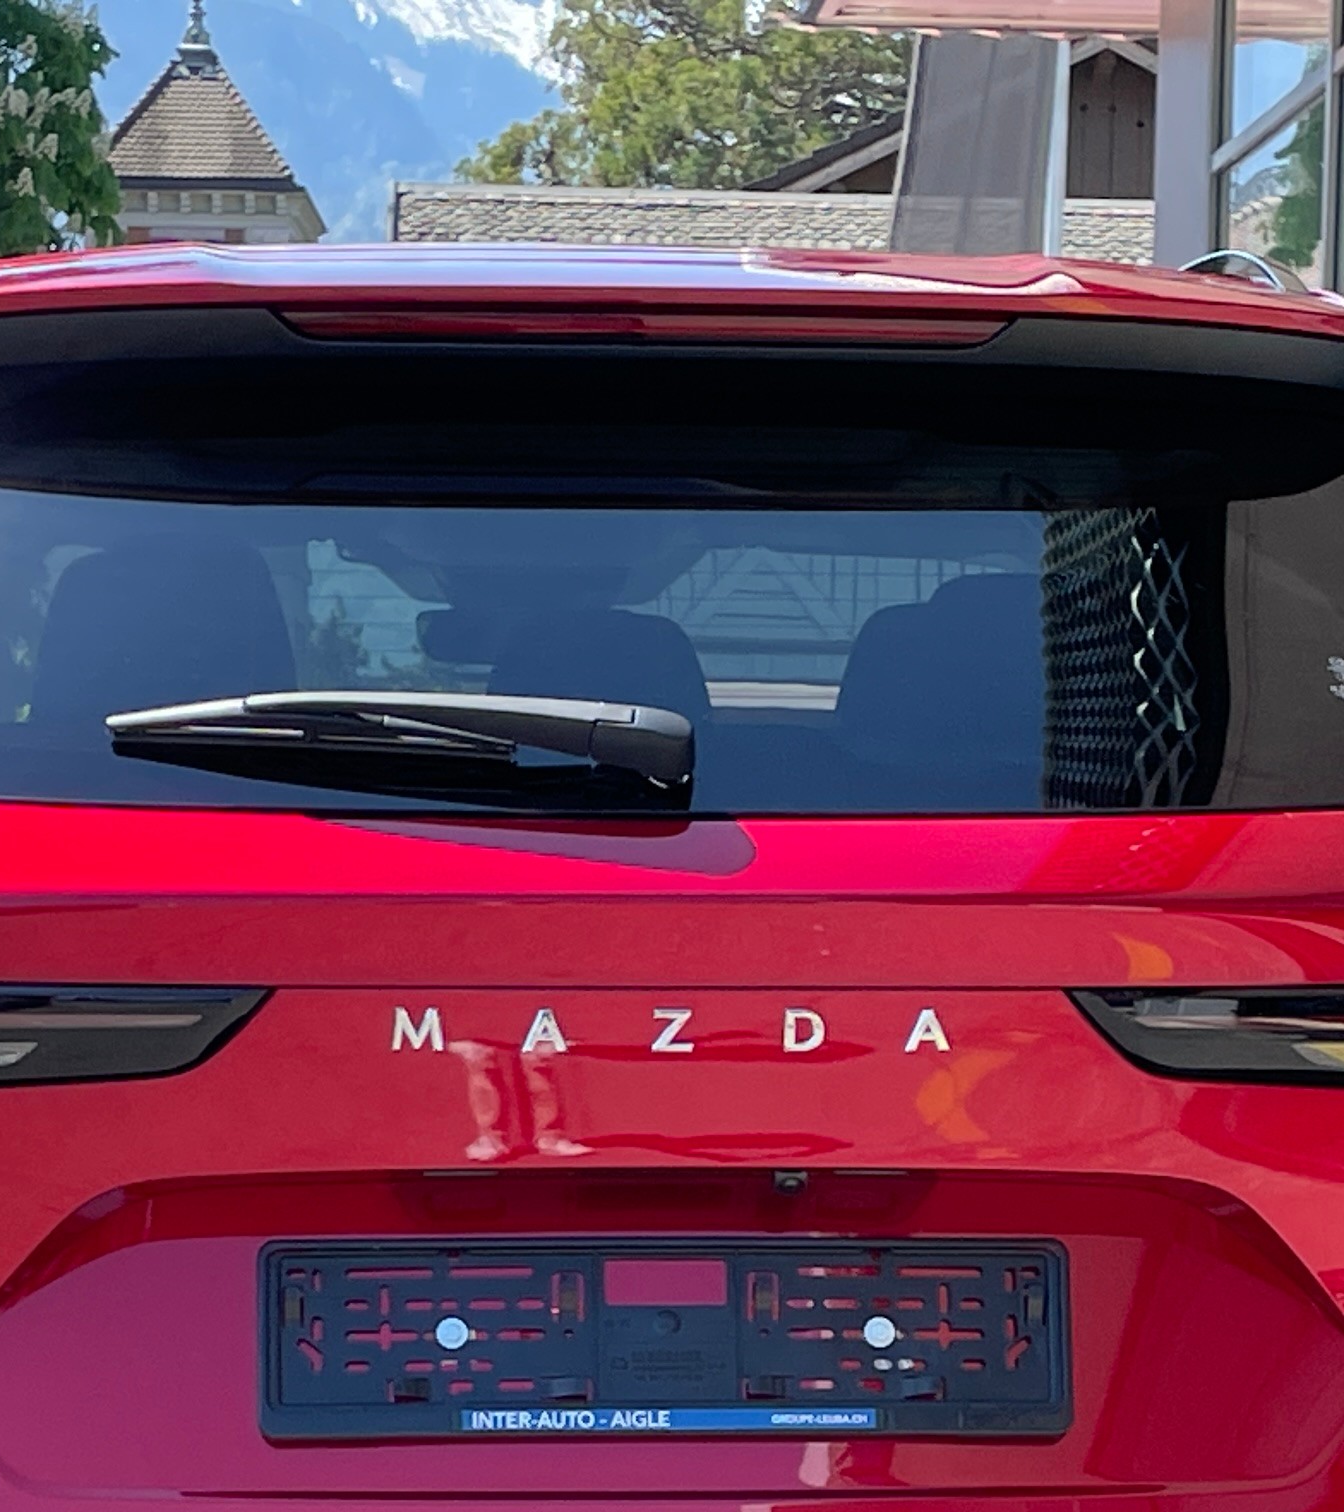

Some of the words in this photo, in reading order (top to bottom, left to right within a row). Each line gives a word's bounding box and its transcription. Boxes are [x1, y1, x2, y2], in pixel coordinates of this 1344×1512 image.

[391, 1007, 951, 1053] MAZDA
[471, 1409, 596, 1429] INTER-AUTO
[610, 1409, 671, 1428] AIGLE
